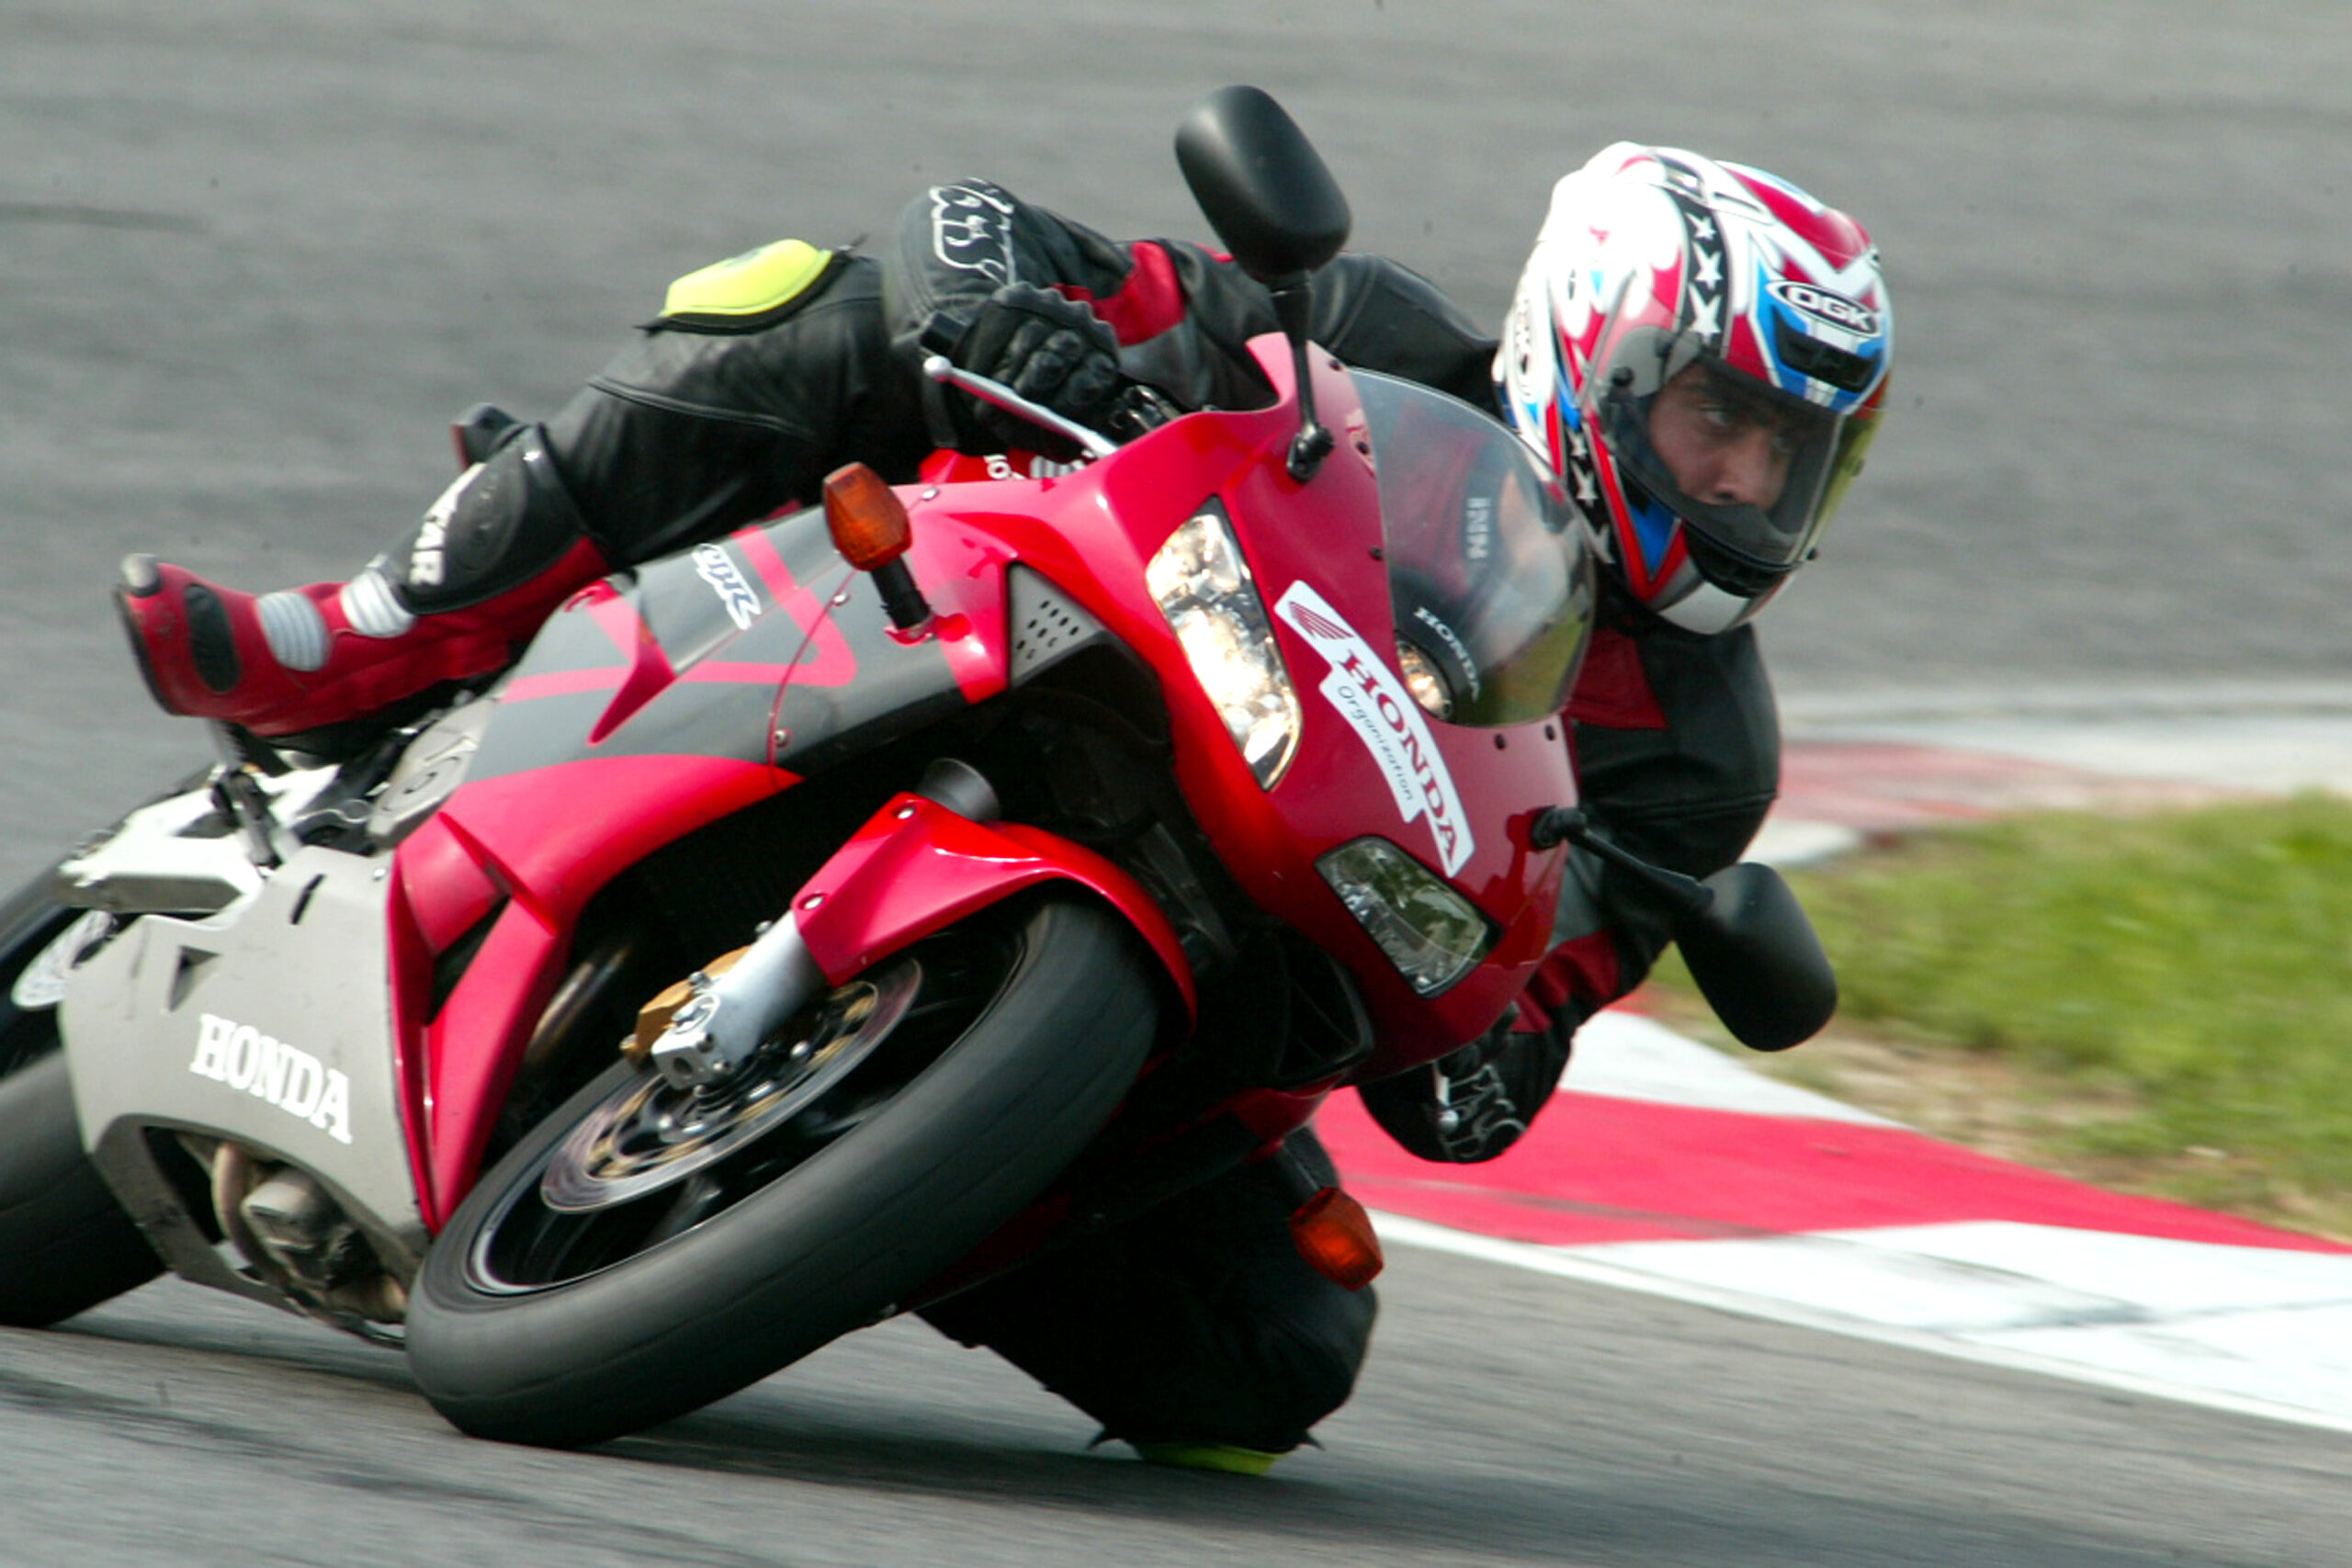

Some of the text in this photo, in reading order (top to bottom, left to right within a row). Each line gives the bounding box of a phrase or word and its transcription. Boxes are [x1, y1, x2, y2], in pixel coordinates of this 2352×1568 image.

[1786, 285, 1871, 333] OGK
[1413, 605, 1482, 703] HONDA
[1338, 685, 1414, 802] Organization
[1338, 649, 1459, 869] HONDA
[189, 1013, 353, 1145] HONDA
